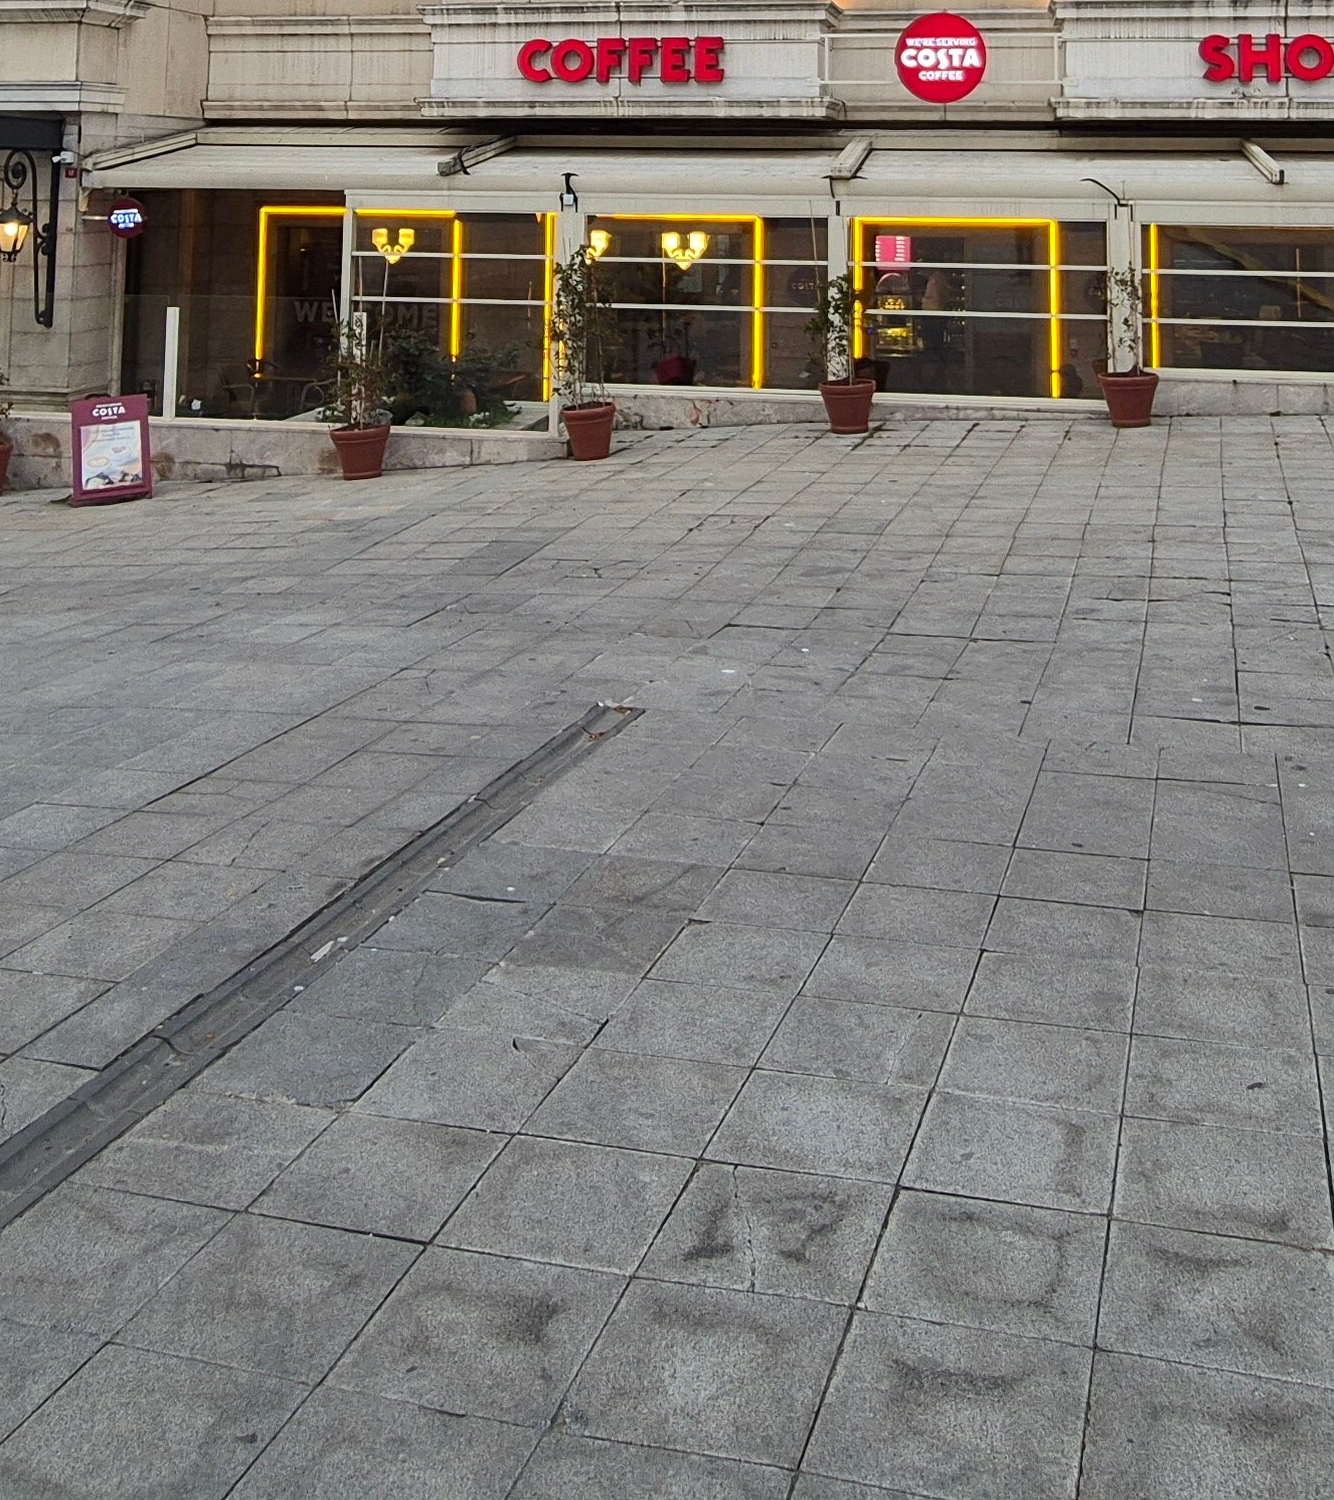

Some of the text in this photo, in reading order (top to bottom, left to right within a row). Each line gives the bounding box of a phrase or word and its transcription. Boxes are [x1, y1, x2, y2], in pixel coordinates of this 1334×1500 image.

[517, 37, 725, 83] COFFEE
[901, 48, 982, 70] COSTA
[918, 70, 965, 82] COFFEE
[110, 212, 142, 224] COSTA
[294, 300, 438, 329] WEOME
[92, 406, 126, 417] COSTA
